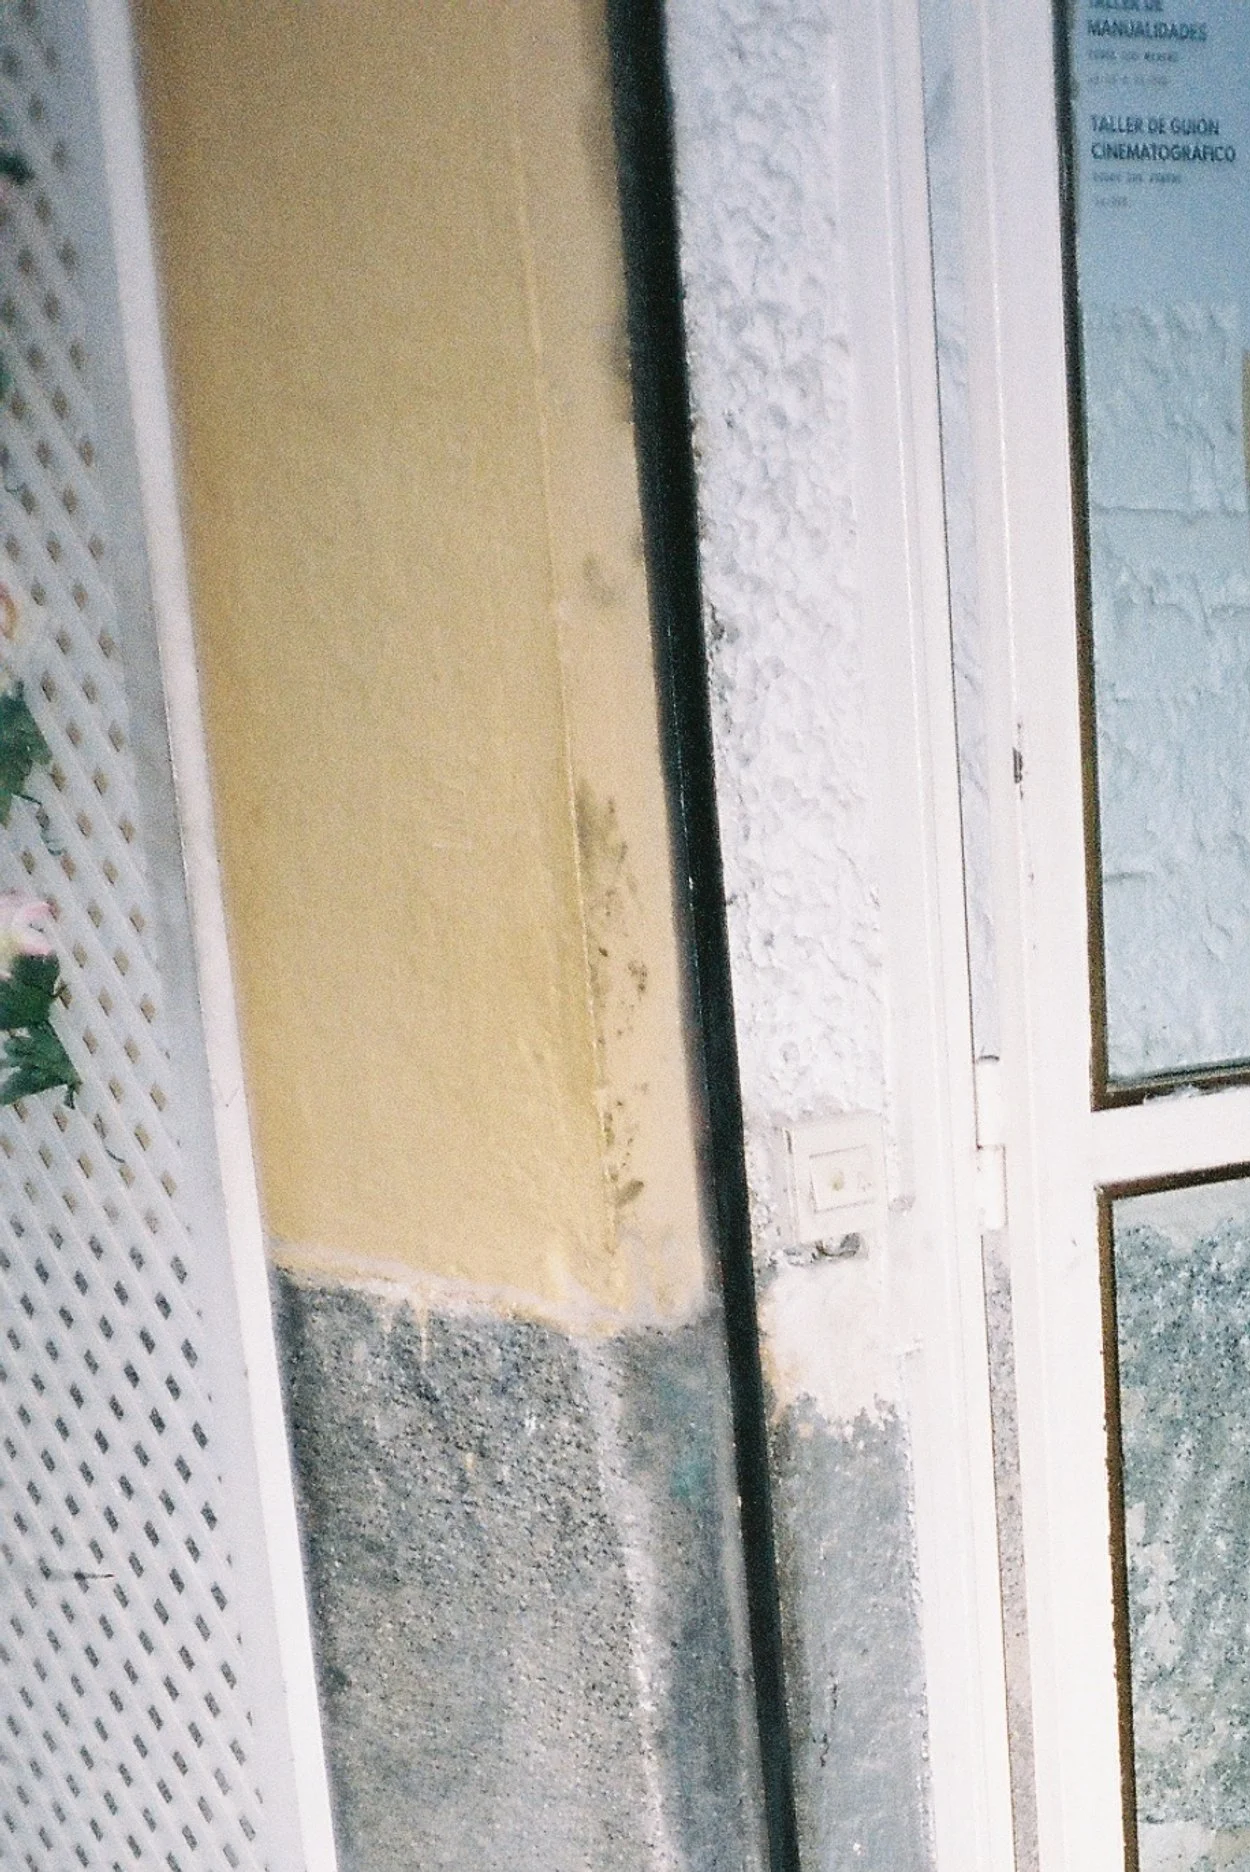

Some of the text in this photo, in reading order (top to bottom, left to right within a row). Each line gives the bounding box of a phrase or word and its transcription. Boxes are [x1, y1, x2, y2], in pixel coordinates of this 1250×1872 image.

[1087, 19, 1207, 42] MANUALIDADES
[1091, 115, 1143, 133] TALLER
[1148, 115, 1166, 134] DE
